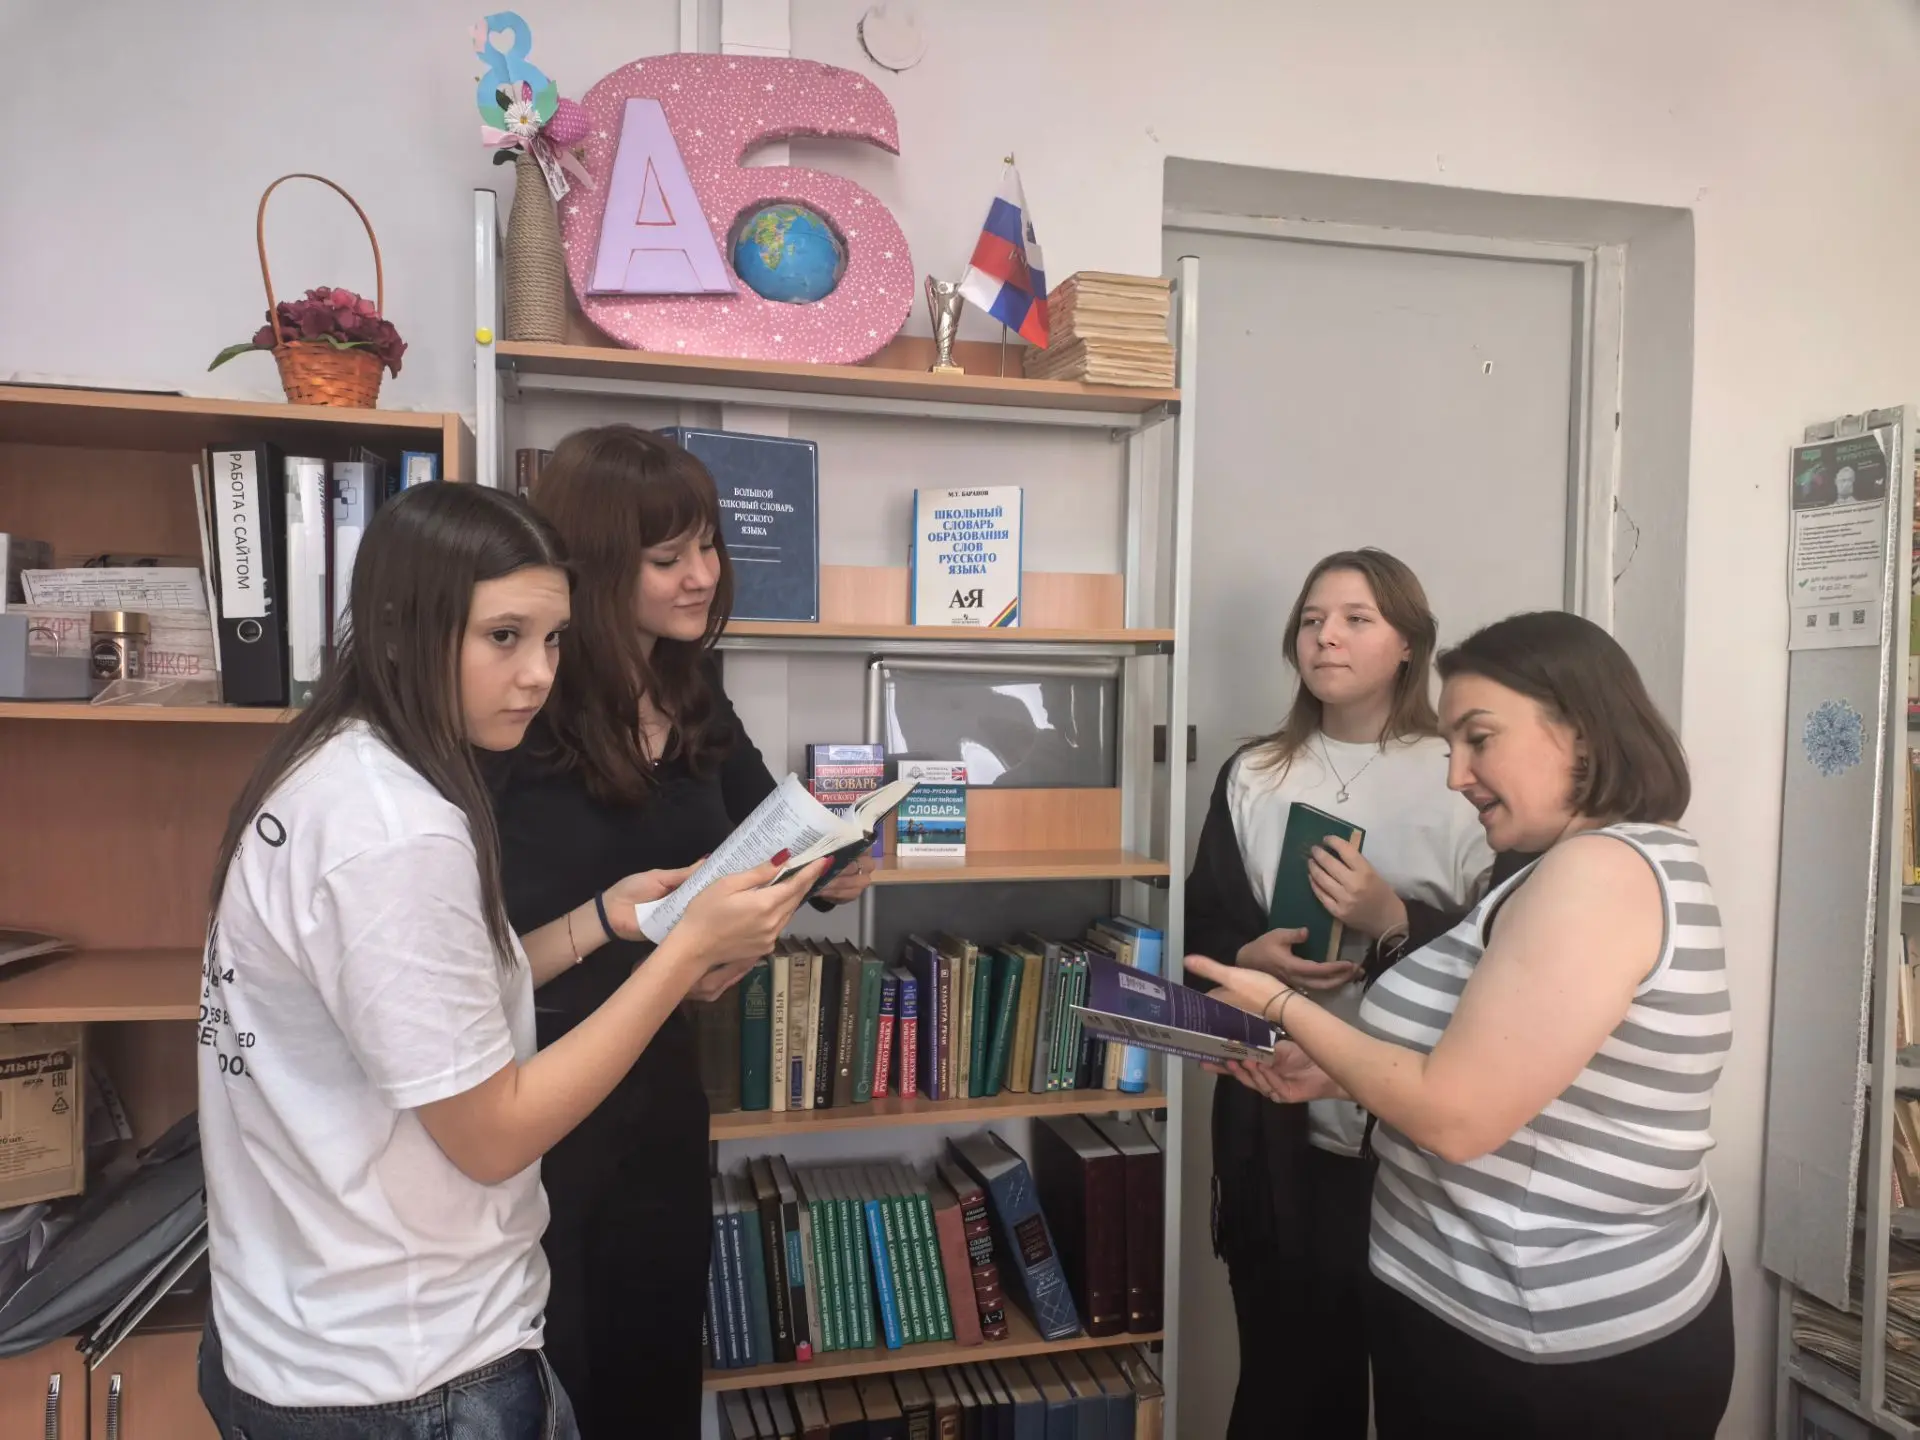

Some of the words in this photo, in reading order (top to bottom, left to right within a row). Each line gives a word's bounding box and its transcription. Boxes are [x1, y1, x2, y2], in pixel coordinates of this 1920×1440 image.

[229, 452, 246, 510] РАБОТА
[734, 487, 773, 498] БОЛЬШОЙ
[719, 499, 758, 510] ОЛКОВЫЙ
[760, 501, 794, 513] СЛОВАРЬ
[934, 505, 1003, 520] ШКОЛЬНЫЙ
[233, 511, 246, 522] С
[734, 513, 774, 523] РУССКОГО
[942, 520, 994, 530] СЛОВАРЬ
[741, 526, 767, 536] ЯЗЫКА
[927, 530, 1009, 542] ОБРАЗОВАНИЯ
[952, 542, 984, 552] СЛОВ
[234, 525, 250, 590] САЙТОМ
[938, 552, 997, 564] РУССКОГО
[948, 564, 987, 574] ЯЗЫКА
[823, 777, 877, 790] СЛОВАРЬ
[908, 805, 960, 815] СЛОВАРЬ
[883, 1021, 891, 1048] ЯЗЫКА
[879, 1050, 888, 1091] РУССКОГО
[908, 1051, 916, 1092] РУССКОГО
[893, 1201, 906, 1239] ШКОЛЬНЫЙ
[906, 1201, 918, 1238] ШКОЛЬНЫЙ
[900, 1242, 911, 1270] СЛОВАРЬ
[913, 1241, 924, 1270] СЛОВАРЬ
[880, 1203, 893, 1241] ШКОЛЬНЫЙ
[887, 1243, 898, 1272] СЛОВАРЬ
[893, 1272, 907, 1318] ИНОСТРАННЫХ
[901, 1320, 910, 1337] СЛОВ
[920, 1200, 932, 1237] ШКОЛЬНЫЙ
[927, 1240, 937, 1268] СЛОВАРЬ
[932, 1269, 945, 1314] ИНОСТРАННЫХ
[940, 1315, 948, 1332] СЛОВ
[905, 1271, 920, 1317] ИНОСТРАННЫХ
[918, 1270, 932, 1316] ИНОСТРАННЫХ
[913, 1318, 923, 1335] СЛОВ
[926, 1317, 935, 1334] СЛОВ
